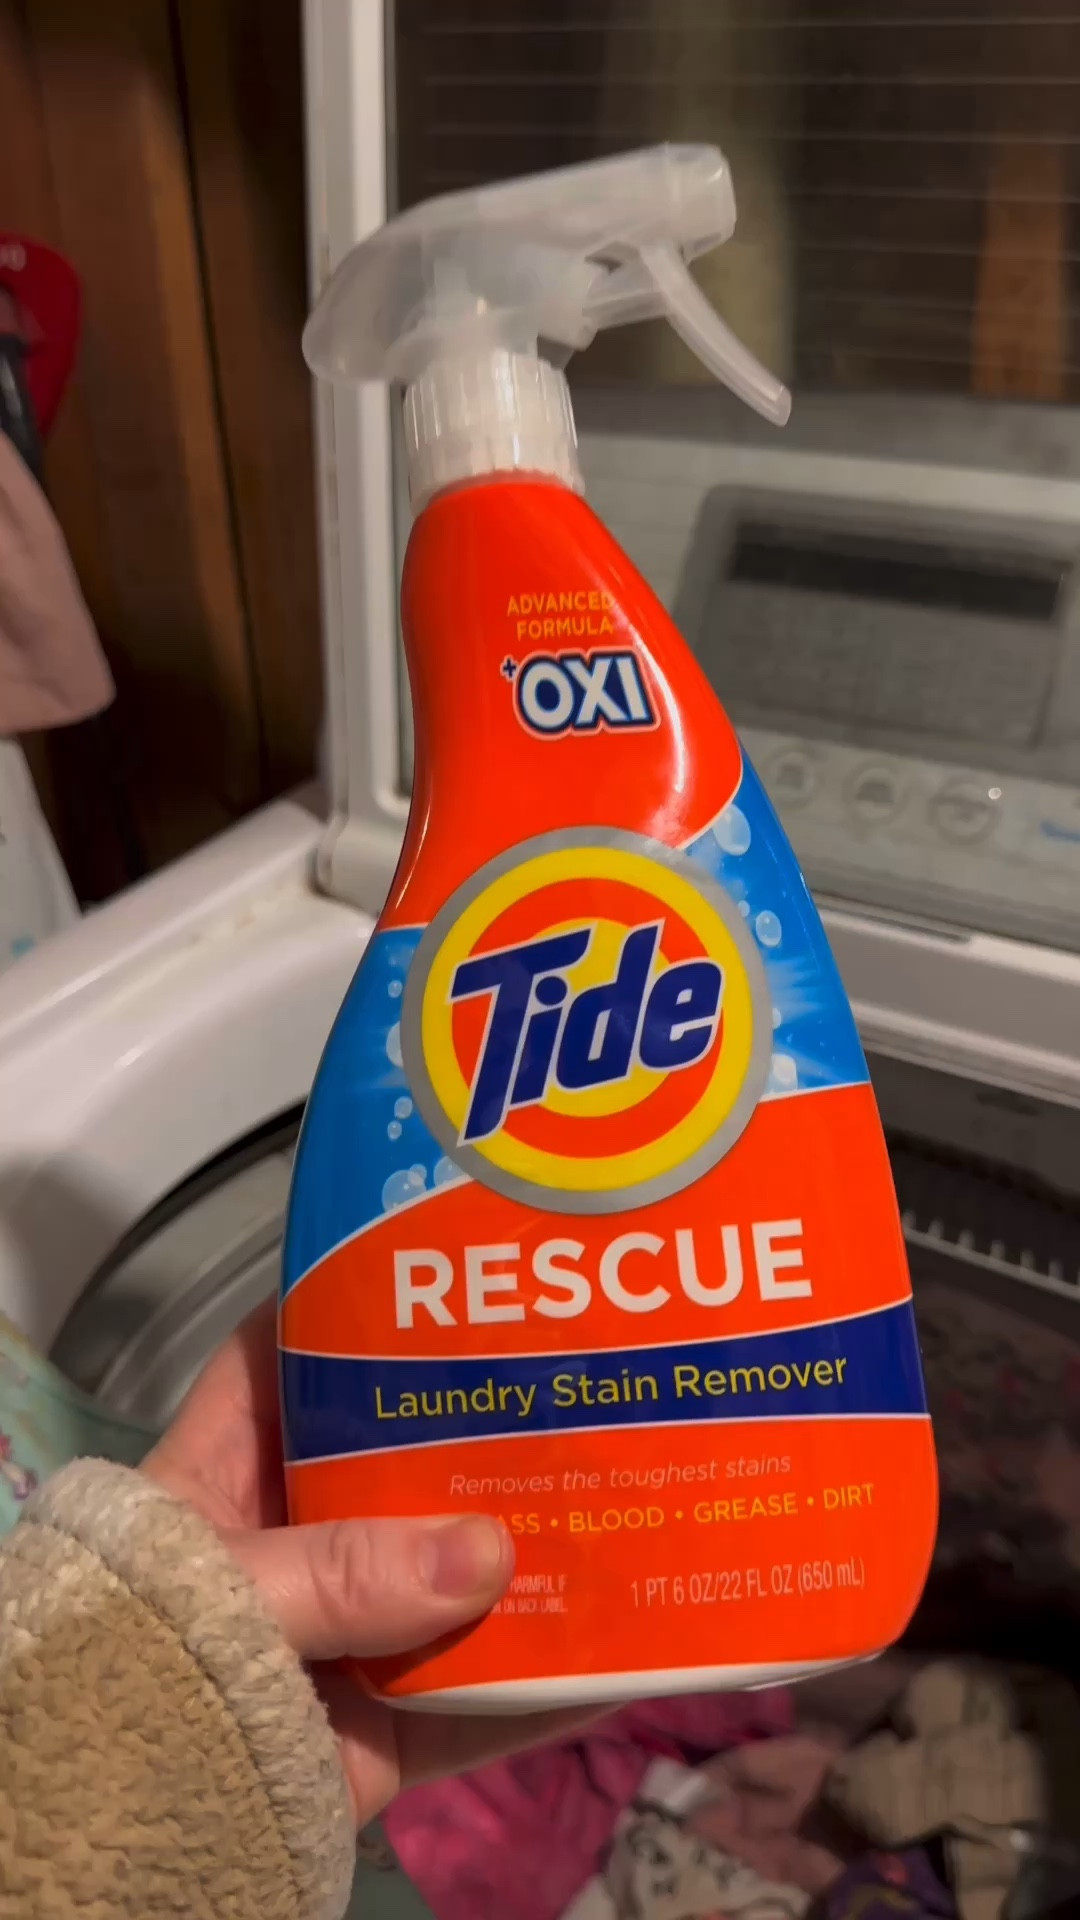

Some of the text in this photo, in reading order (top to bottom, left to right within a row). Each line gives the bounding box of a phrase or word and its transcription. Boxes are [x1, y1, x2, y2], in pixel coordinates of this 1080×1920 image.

[507, 591, 615, 616] ADVANCED
[516, 616, 614, 641] FORMULA
[447, 918, 725, 1147] Tide
[393, 1218, 813, 1328] RESCUE
[375, 1356, 847, 1420] Laundry Stain Remover
[450, 1453, 791, 1496] Removes the toughest stains
[569, 1506, 664, 1533] BLOOD
[694, 1492, 798, 1523] GREASE
[823, 1483, 874, 1510] DIRT
[630, 1555, 865, 1608] 1 PT 6 OZ/22 FL OZ (650 mL)
